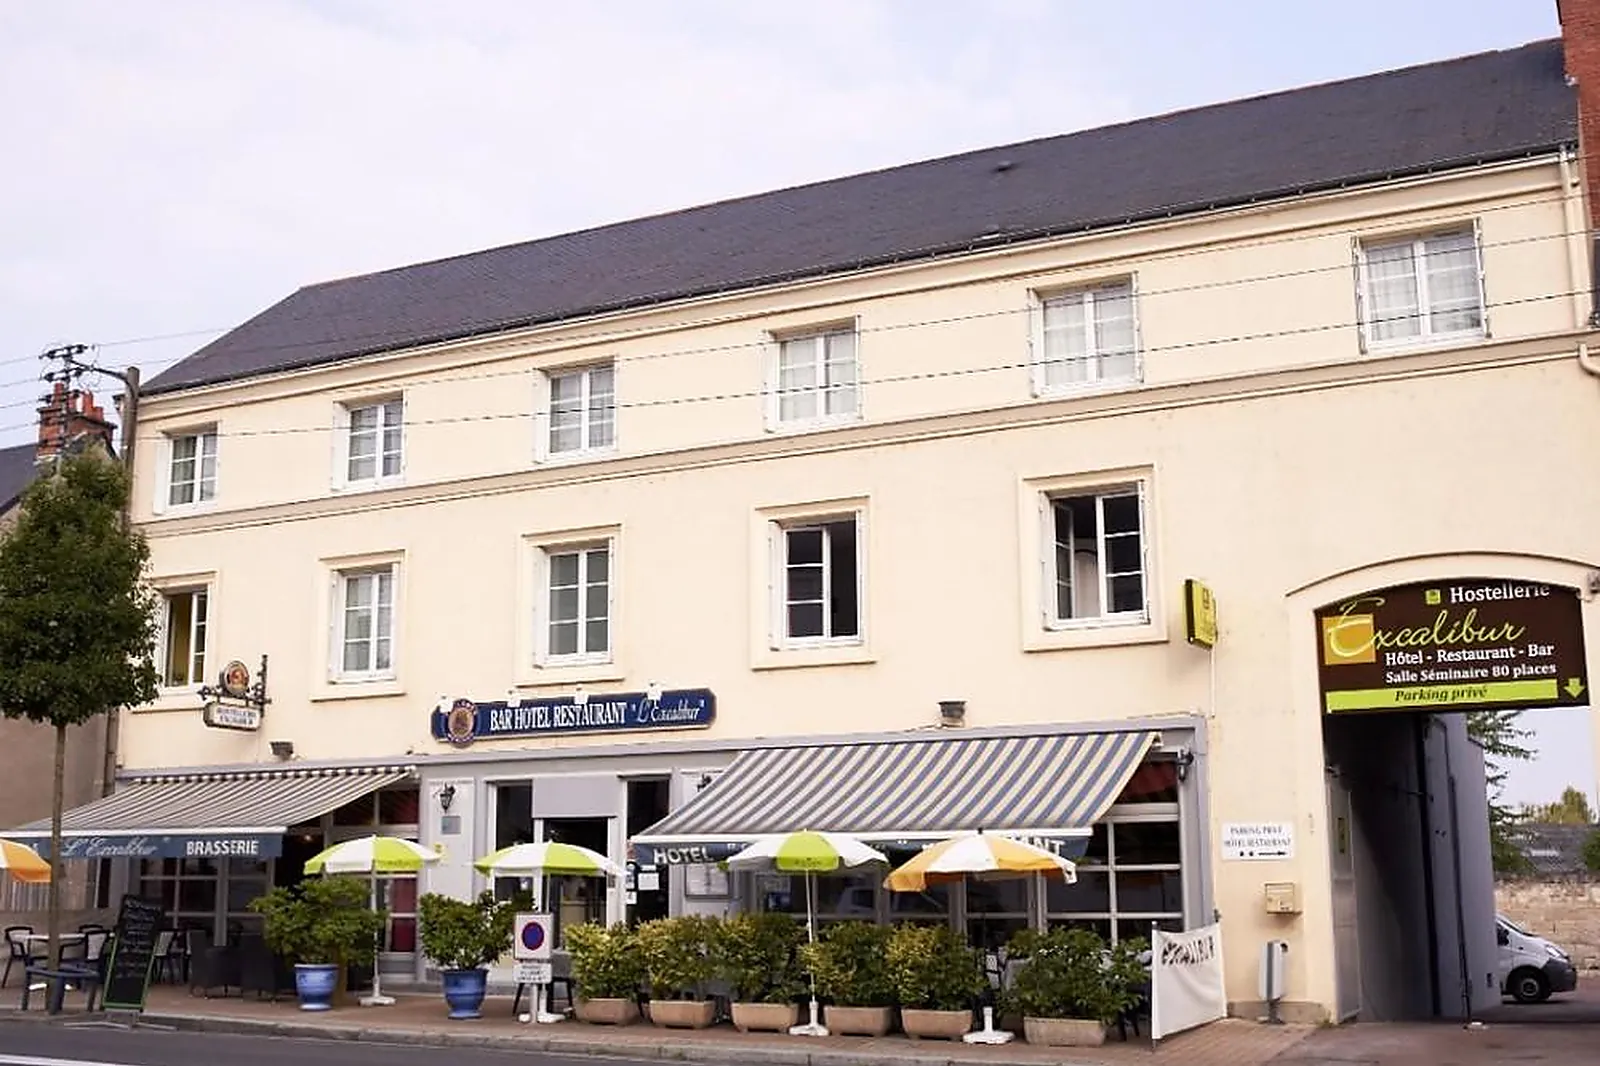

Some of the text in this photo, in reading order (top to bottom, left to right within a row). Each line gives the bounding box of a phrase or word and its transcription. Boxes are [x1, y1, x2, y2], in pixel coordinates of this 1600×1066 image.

[1449, 583, 1549, 603] Hostellerie
[1328, 596, 1525, 657] Excalibur
[1386, 649, 1423, 666] Hôtel
[1437, 646, 1515, 663] Restaurant
[1528, 644, 1555, 657] Bar
[1386, 663, 1557, 684] Salle Séminaire 80 places
[1395, 686, 1488, 703] Parking privé
[490, 708, 514, 731] BAR
[515, 706, 551, 729] HOTEL
[554, 701, 627, 726] RESTAURANT
[186, 839, 259, 856] BRASSERIE
[653, 846, 713, 866] HOTEL
